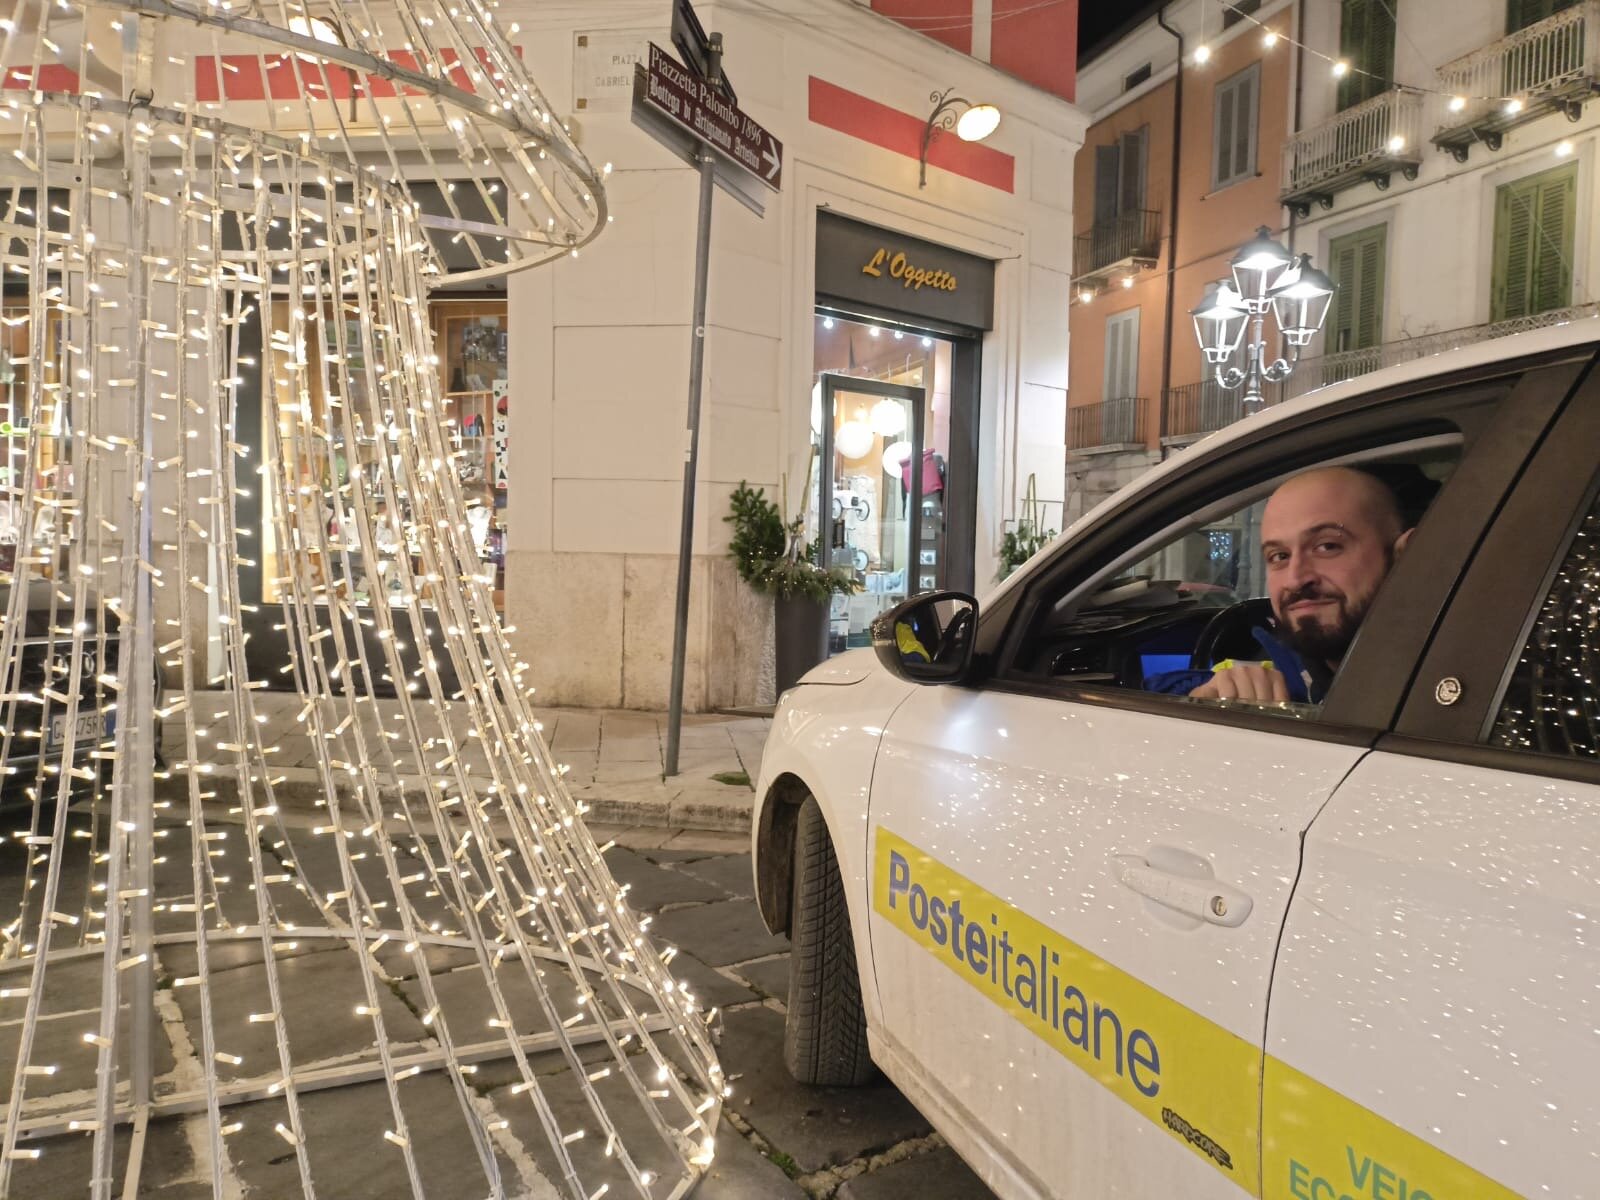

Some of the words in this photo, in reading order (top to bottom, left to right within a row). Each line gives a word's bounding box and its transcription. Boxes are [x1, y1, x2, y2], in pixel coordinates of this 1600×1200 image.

[612, 54, 643, 65] PIAZZA
[595, 76, 631, 87] GABRIEL
[651, 47, 697, 98] Piazzetta
[700, 82, 740, 129] Palombo
[741, 116, 762, 146] 1896
[683, 100, 692, 121] di
[863, 248, 957, 291] L'Oggetto
[889, 849, 1161, 1098] Posteitaliane
[1289, 1157, 1355, 1200] EC
[1346, 1144, 1433, 1200] VEI
